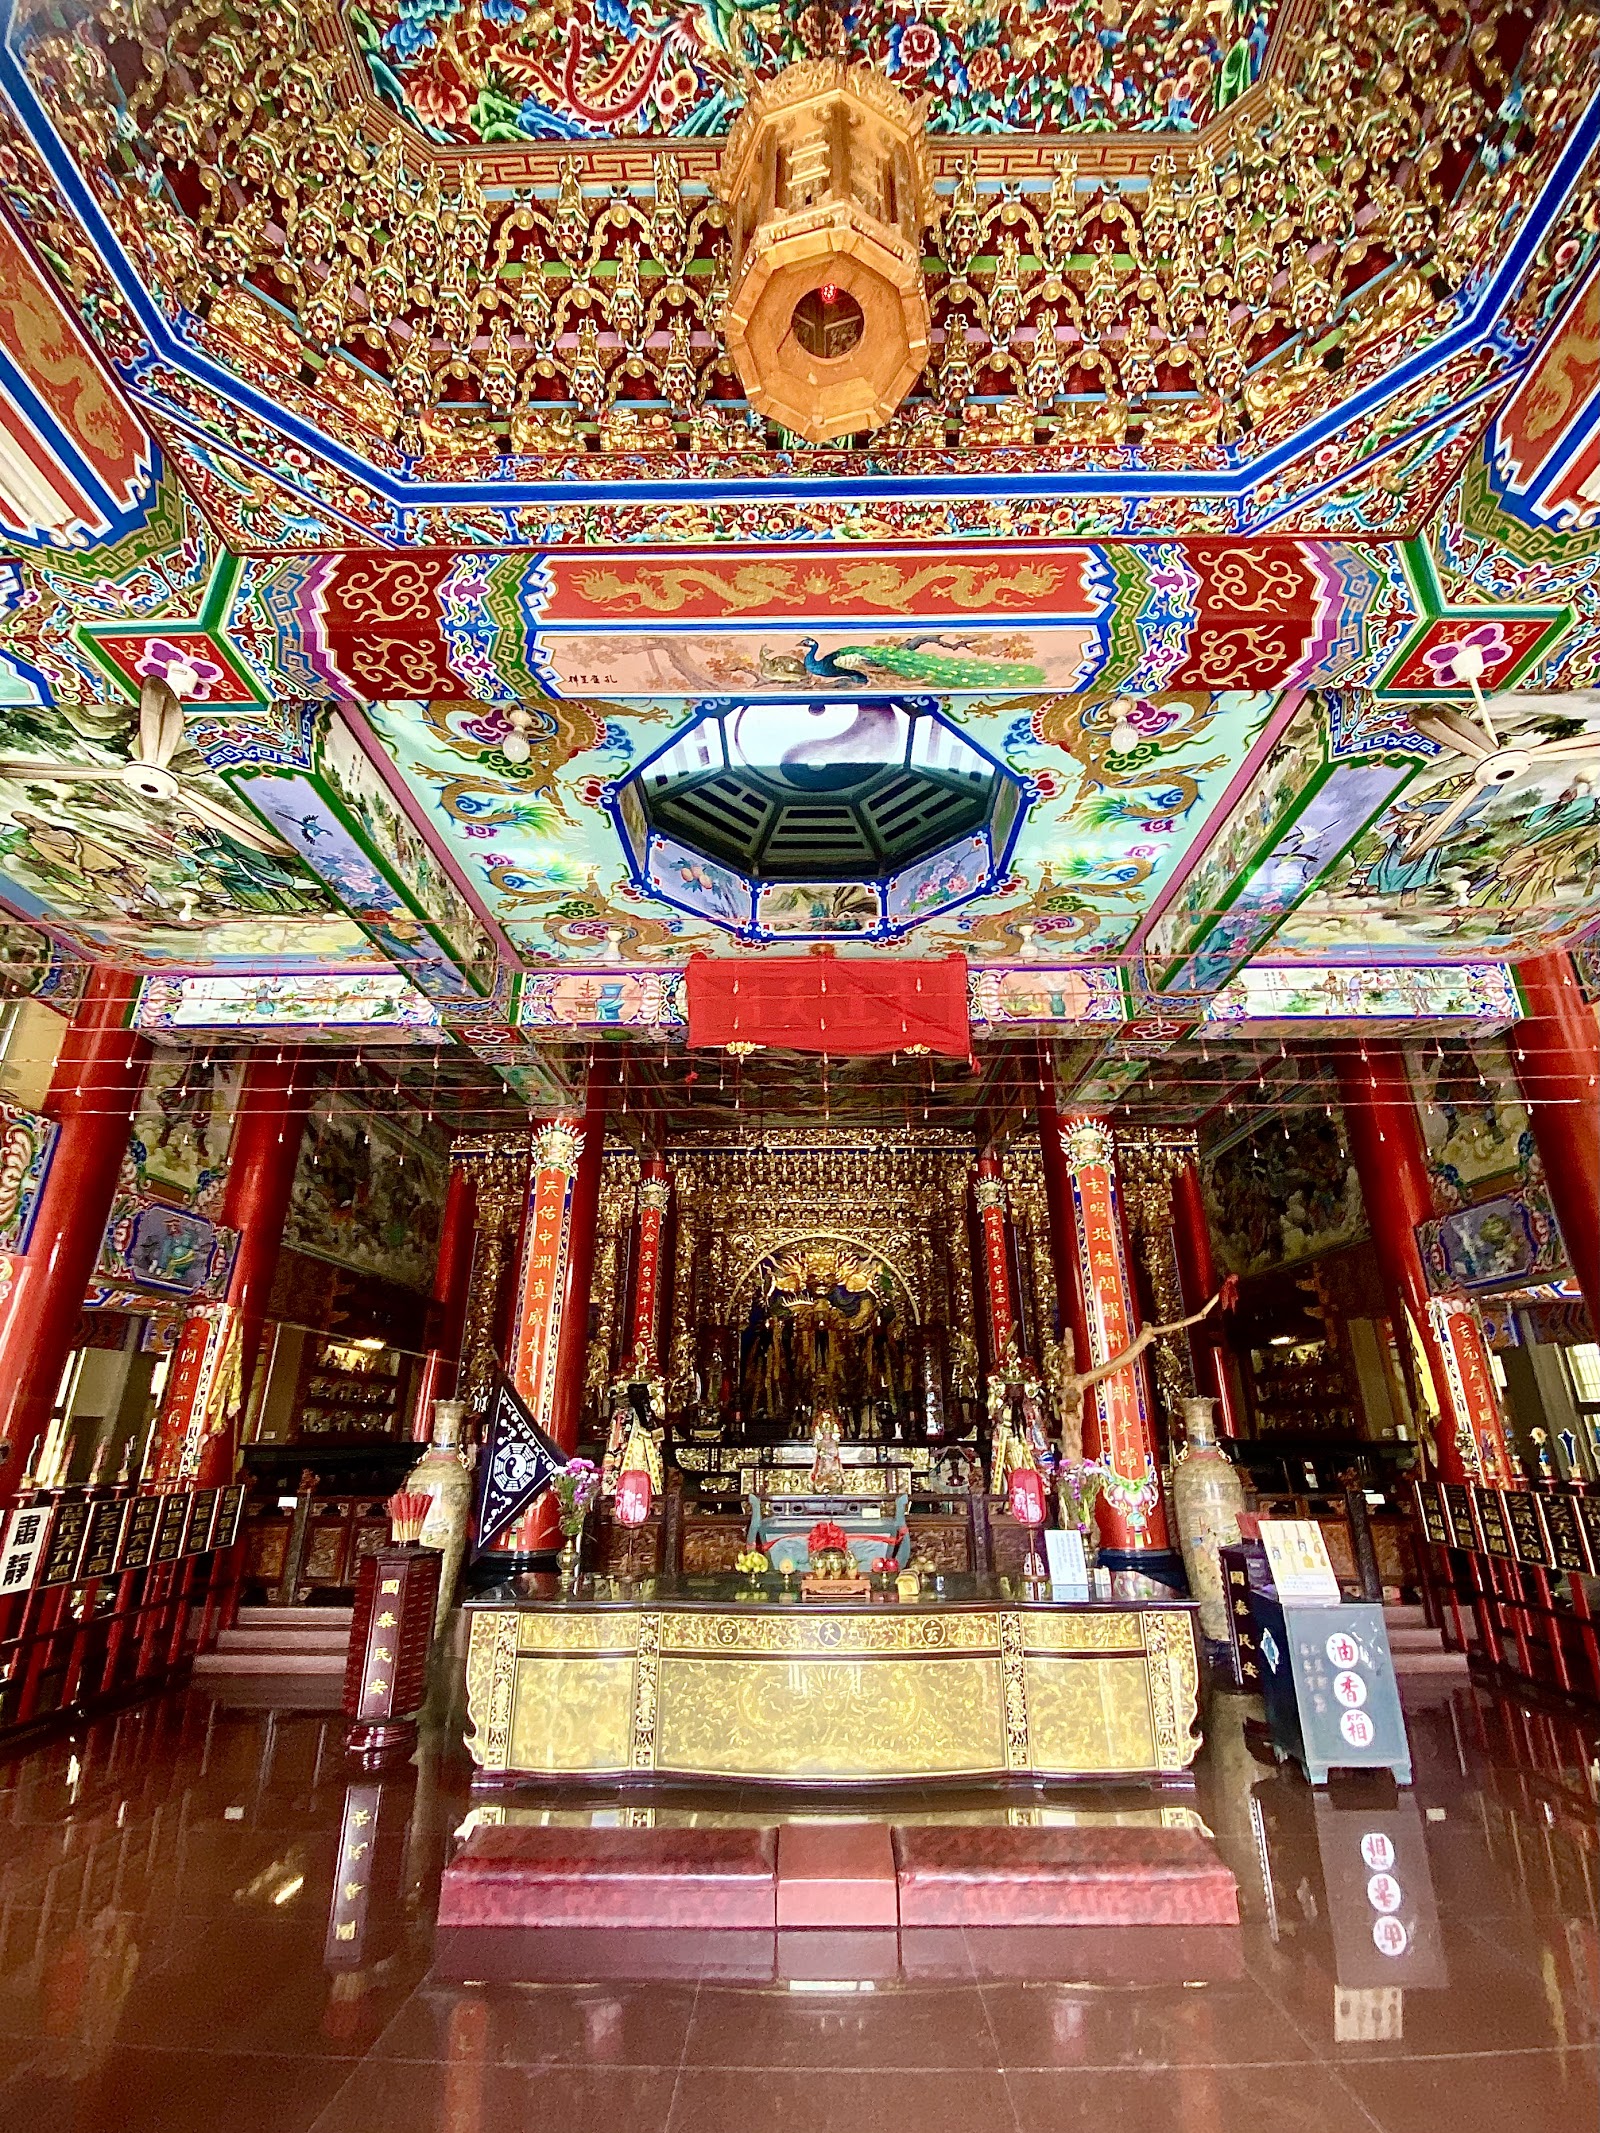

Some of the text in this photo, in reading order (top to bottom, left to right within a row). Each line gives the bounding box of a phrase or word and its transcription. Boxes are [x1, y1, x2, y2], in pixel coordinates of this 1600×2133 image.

[3, 1514, 41, 1586] 肅靜
[366, 1579, 400, 1696] 國泰民安
[1231, 1571, 1260, 1679] 國泰民安
[1332, 1638, 1367, 1742] 油香箱
